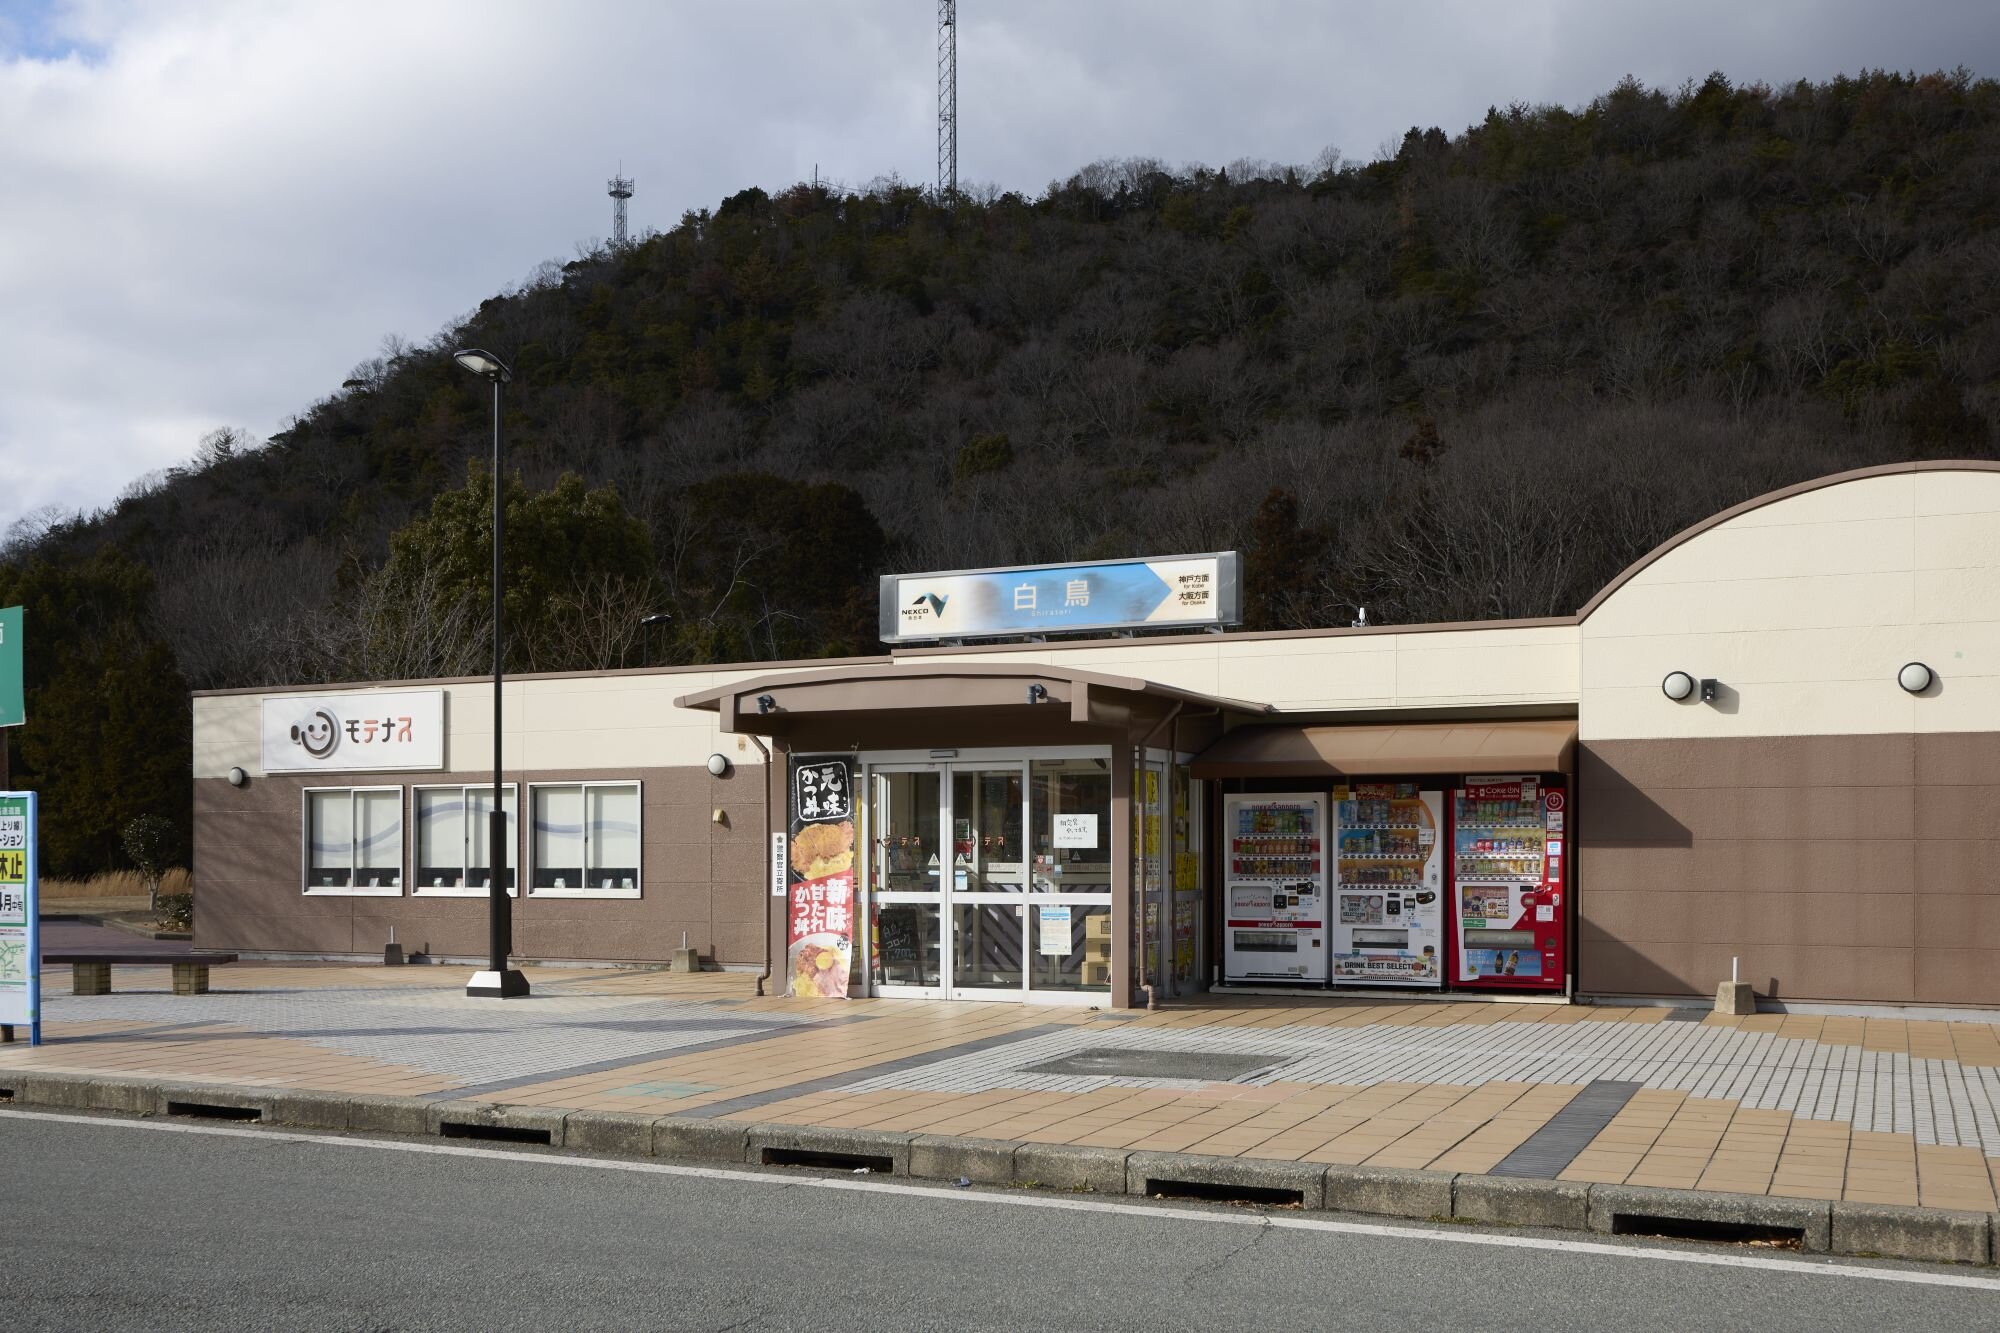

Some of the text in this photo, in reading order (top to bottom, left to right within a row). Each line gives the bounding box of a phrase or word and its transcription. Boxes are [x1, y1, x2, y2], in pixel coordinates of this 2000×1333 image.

[1179, 574, 1209, 583] 神戸方面
[1014, 579, 1090, 611] 白鳥
[1179, 590, 1209, 600] 大阪方面
[902, 608, 929, 616] NEXCO
[345, 717, 412, 744] モテナス
[802, 769, 820, 817] かつ丼
[1486, 786, 1506, 794] Coke
[794, 886, 810, 936] かつ丼
[810, 884, 825, 932] 甘たれ
[826, 878, 847, 931] 新味
